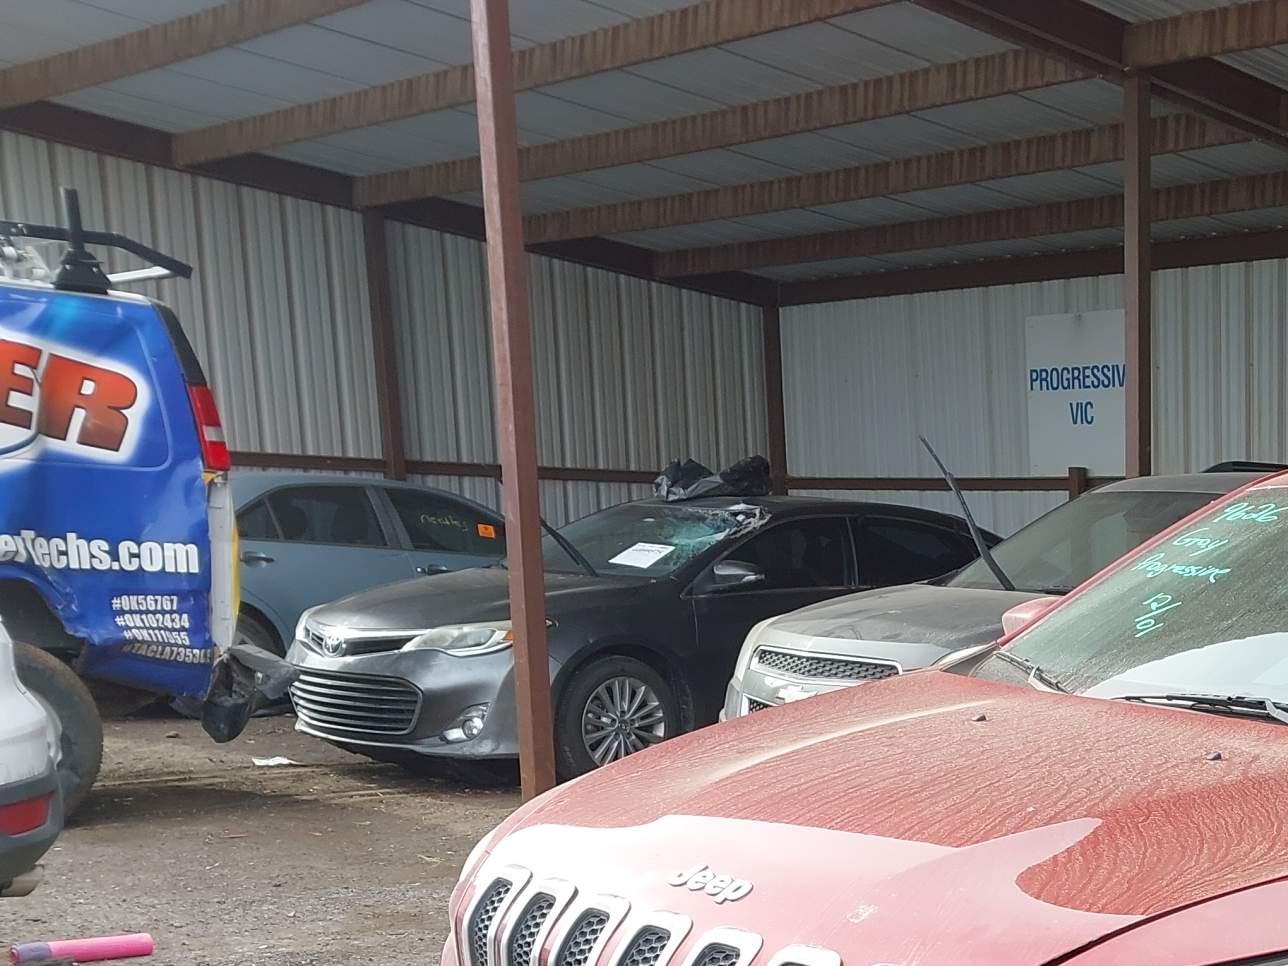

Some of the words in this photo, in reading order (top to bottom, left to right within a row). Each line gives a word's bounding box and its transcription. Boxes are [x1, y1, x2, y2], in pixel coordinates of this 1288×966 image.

[1069, 401, 1095, 425] VIC
[111, 595, 178, 610] #OK56767
[114, 613, 190, 629] #OK102434
[666, 863, 754, 905] Jeep
